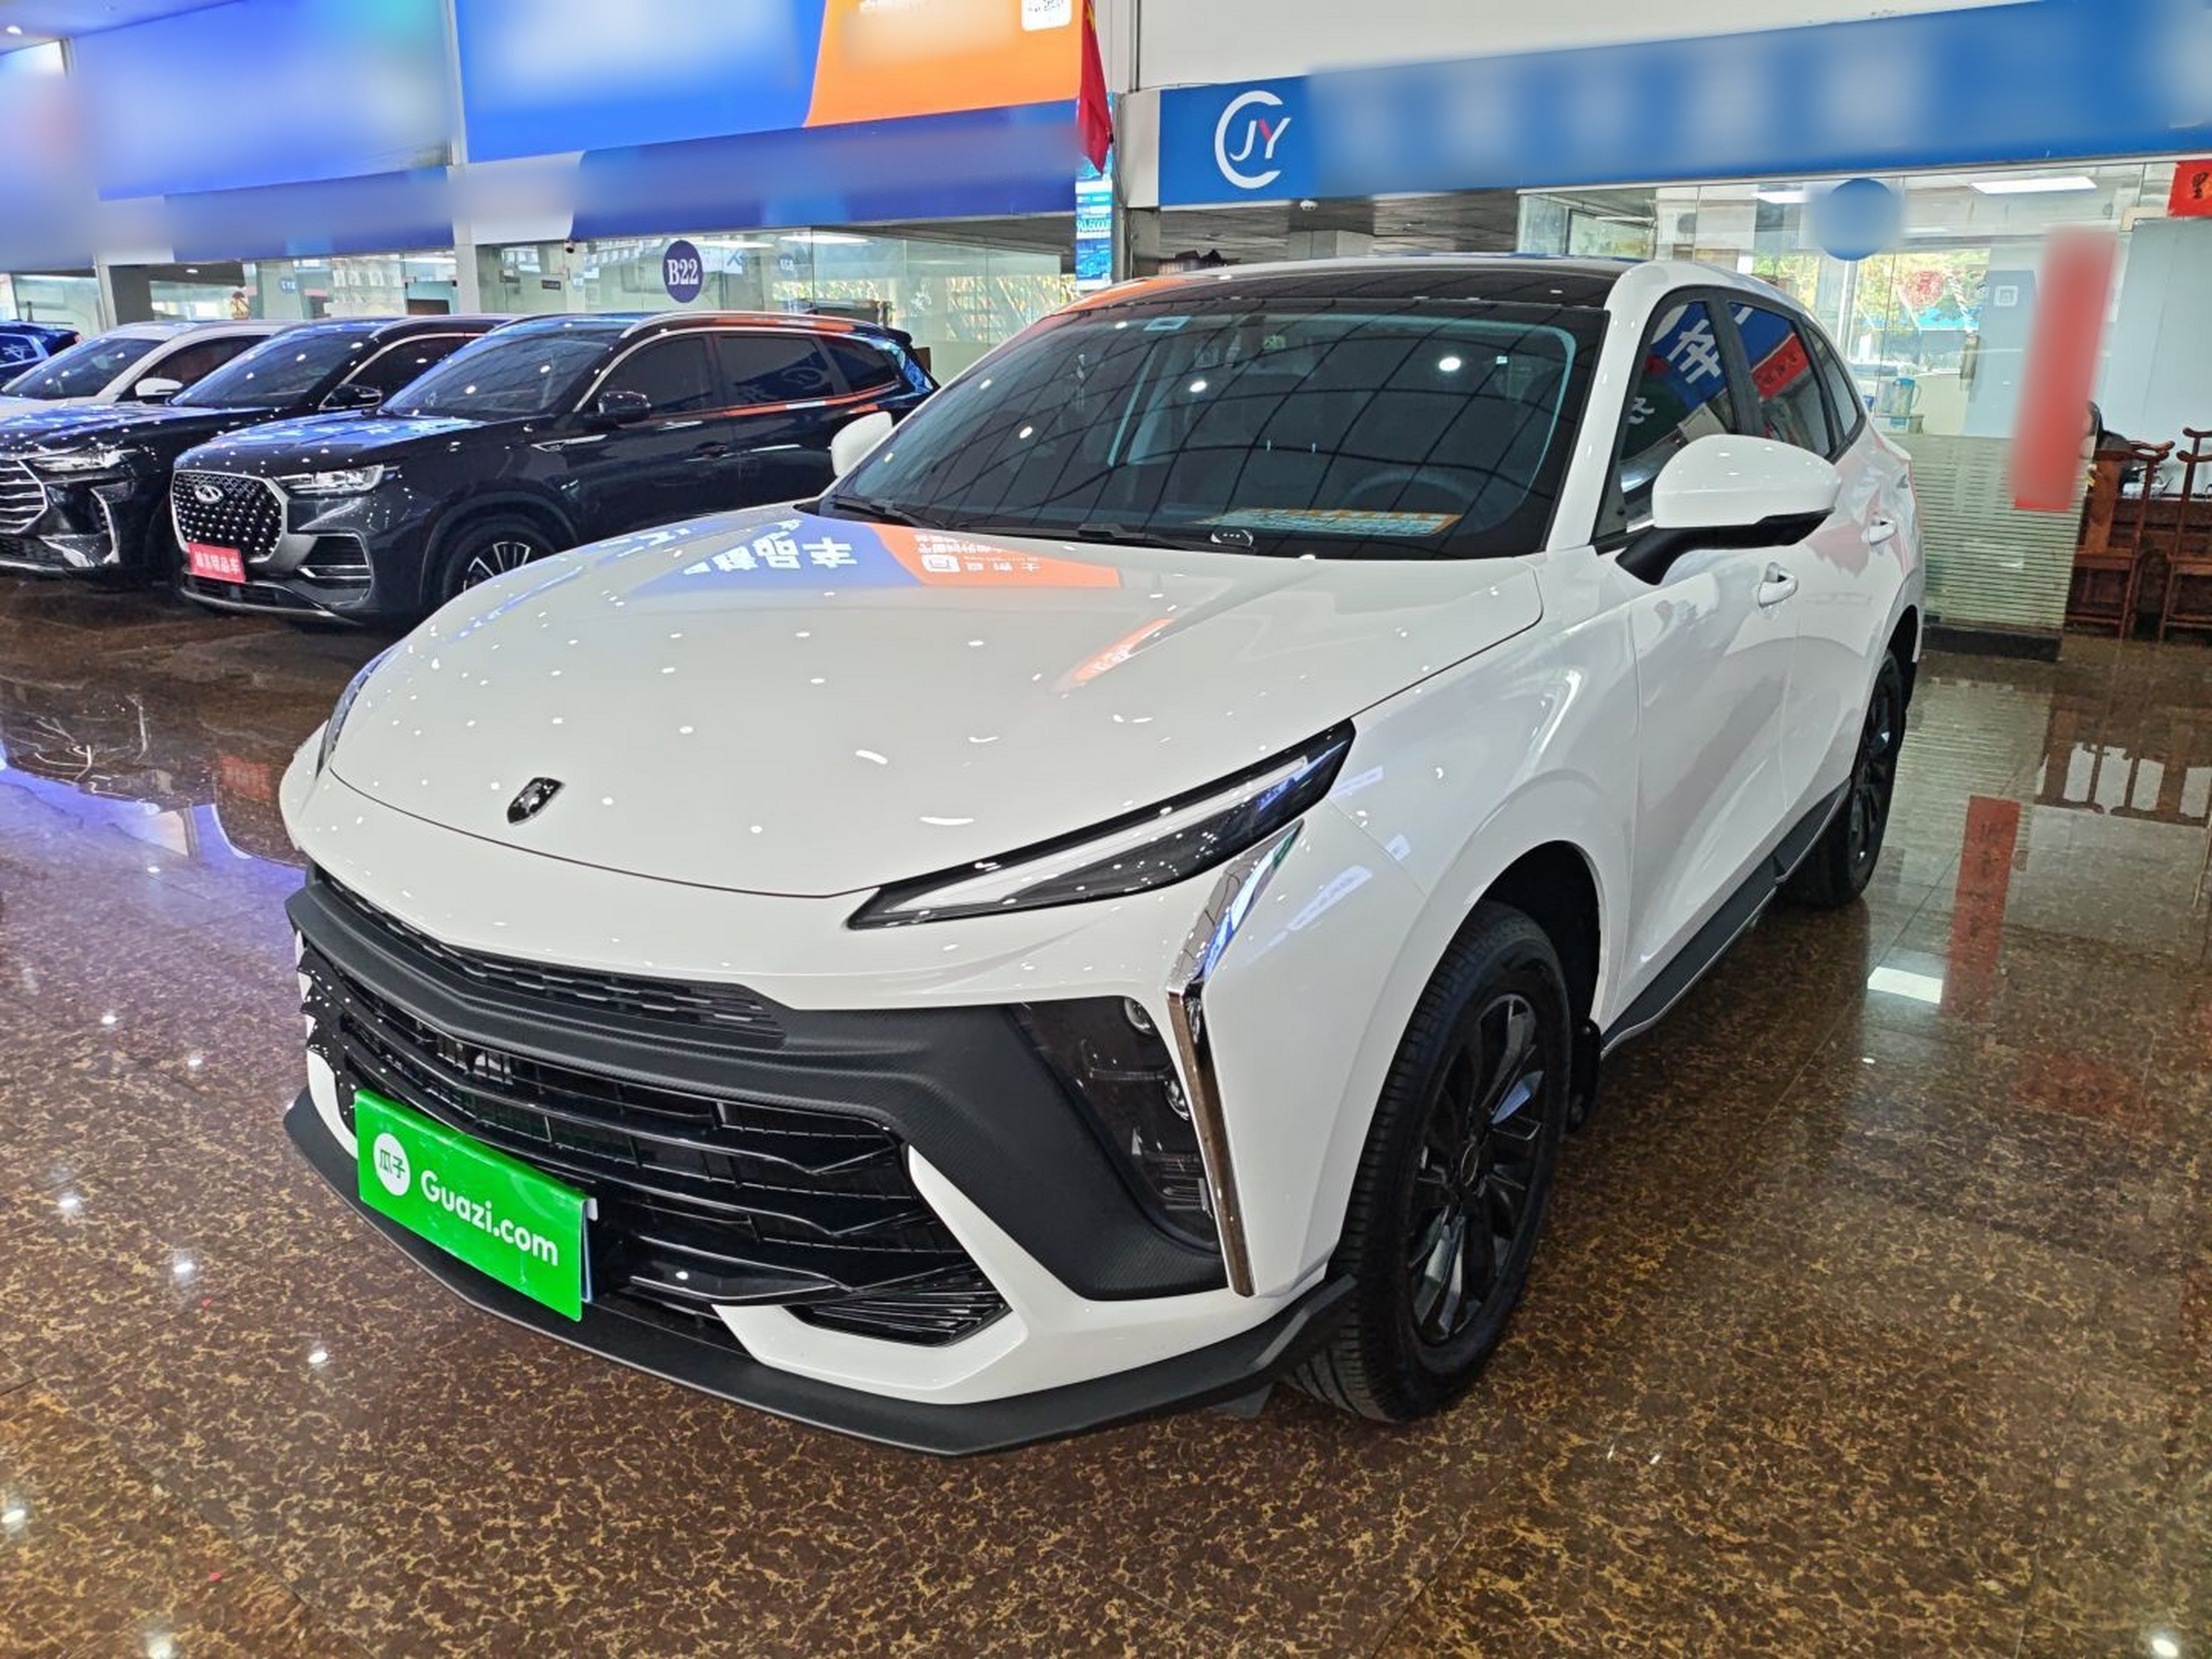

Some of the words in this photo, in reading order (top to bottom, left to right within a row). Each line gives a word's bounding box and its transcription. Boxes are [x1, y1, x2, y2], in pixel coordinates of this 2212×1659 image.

[667, 258, 699, 285] B22
[379, 1148, 406, 1179] 瓜子
[421, 1170, 558, 1267] Guazi.com
